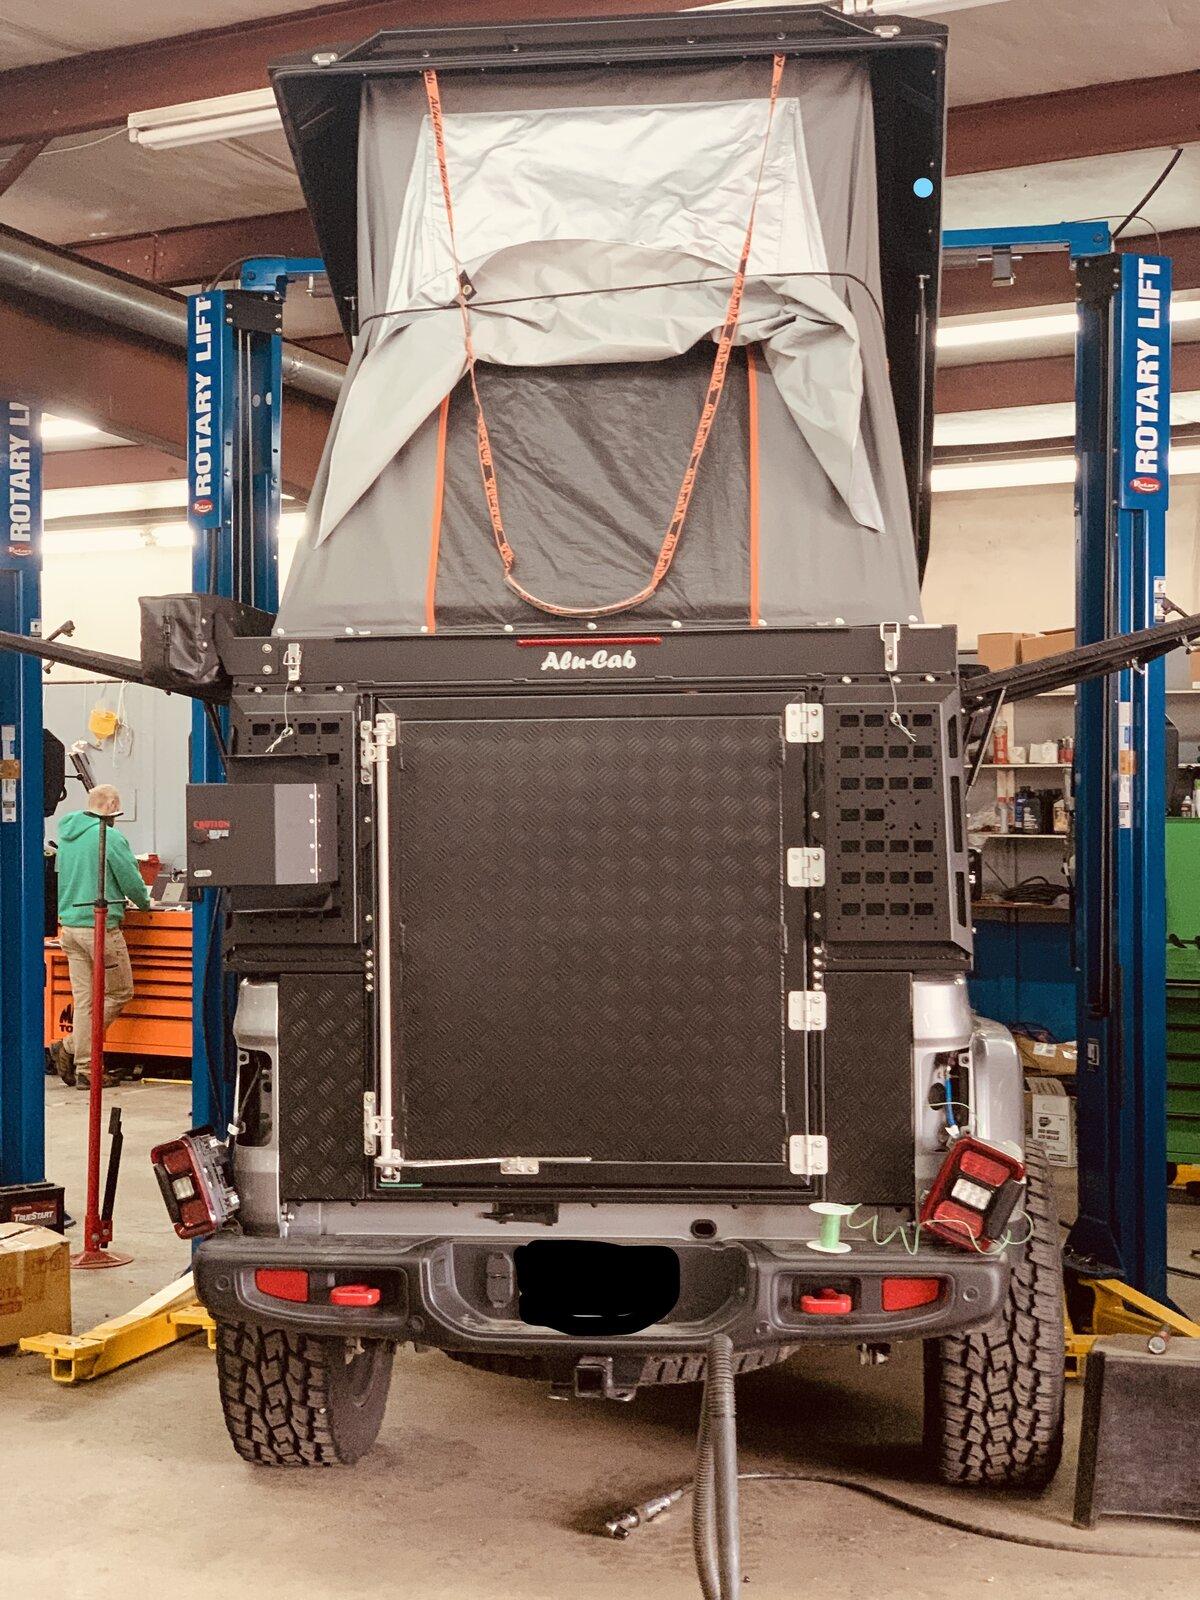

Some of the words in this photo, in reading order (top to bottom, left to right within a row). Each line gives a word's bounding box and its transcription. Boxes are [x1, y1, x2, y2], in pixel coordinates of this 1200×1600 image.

[1137, 258, 1162, 329] LIFT
[195, 297, 212, 362] LIFT
[9, 402, 30, 426] LI
[195, 372, 212, 497] ROTARY
[1134, 338, 1160, 474] ROTARY
[9, 433, 31, 542] ROTARY
[540, 649, 638, 671] Alu-Cab
